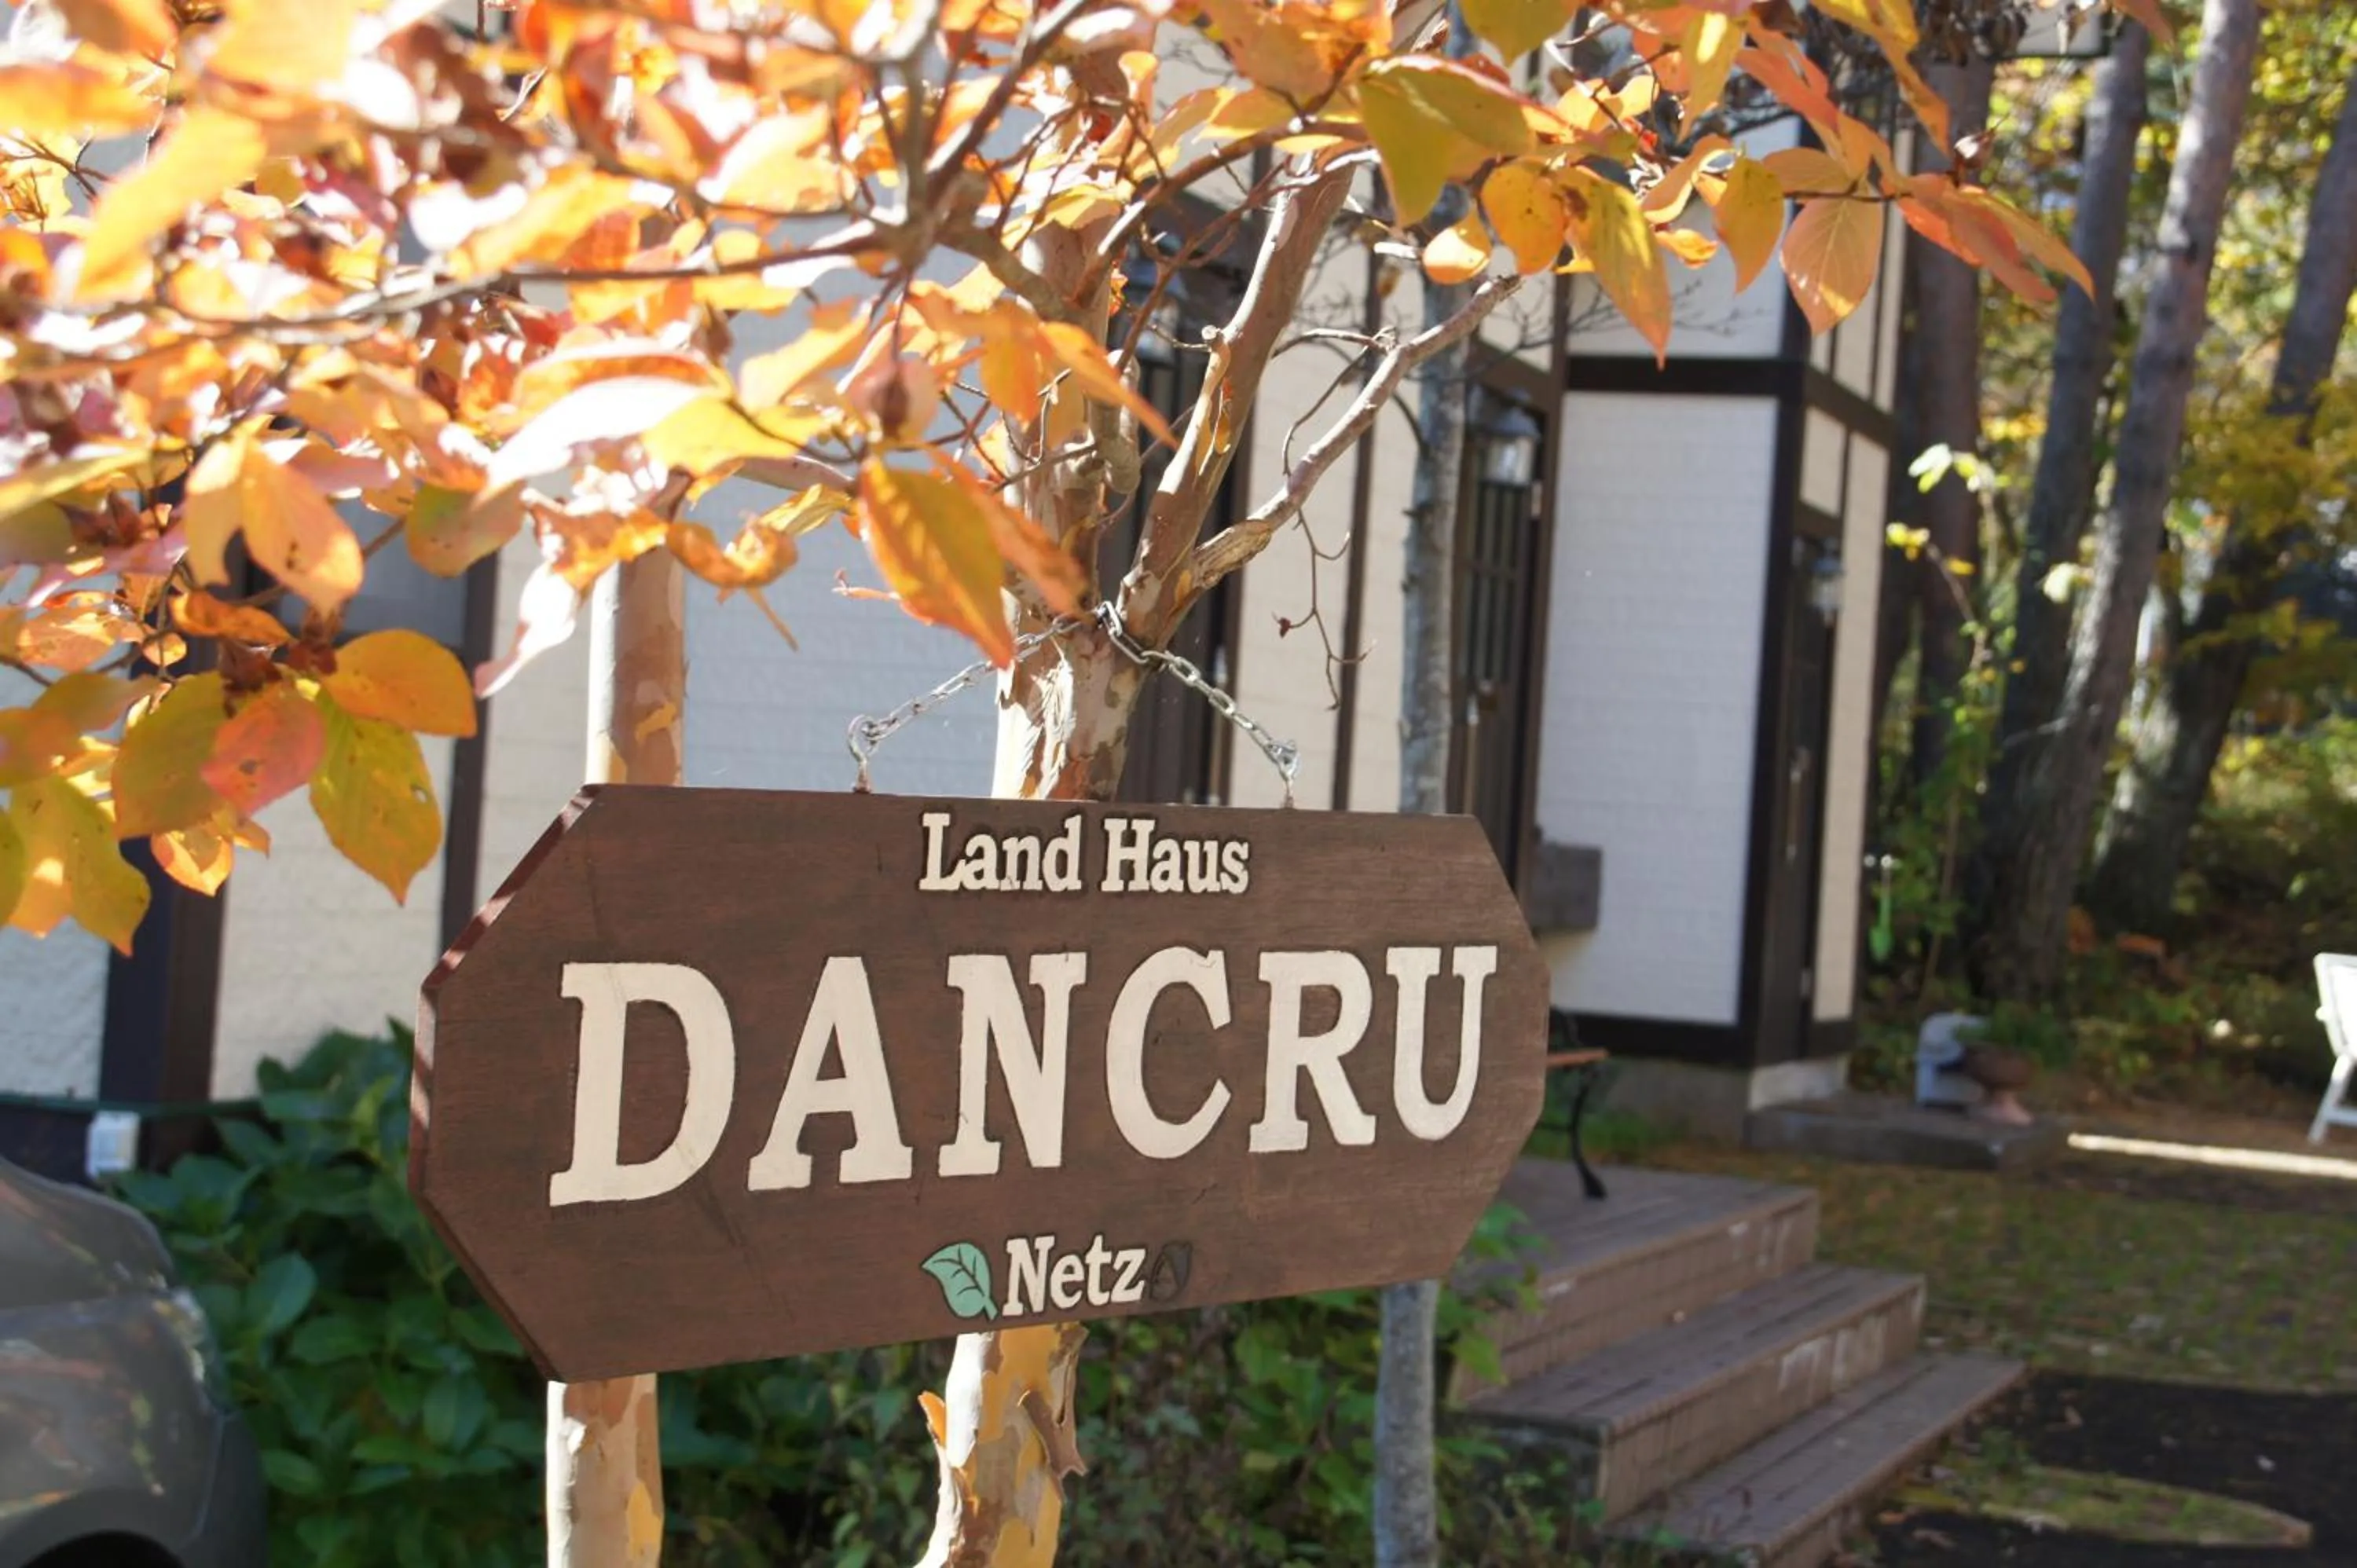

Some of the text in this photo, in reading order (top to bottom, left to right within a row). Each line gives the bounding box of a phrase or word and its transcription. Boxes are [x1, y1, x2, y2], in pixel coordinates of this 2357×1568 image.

[918, 811, 1249, 894] Land Haus
[548, 945, 1497, 1207] DANCRU
[1002, 1234, 1146, 1317] Netz
